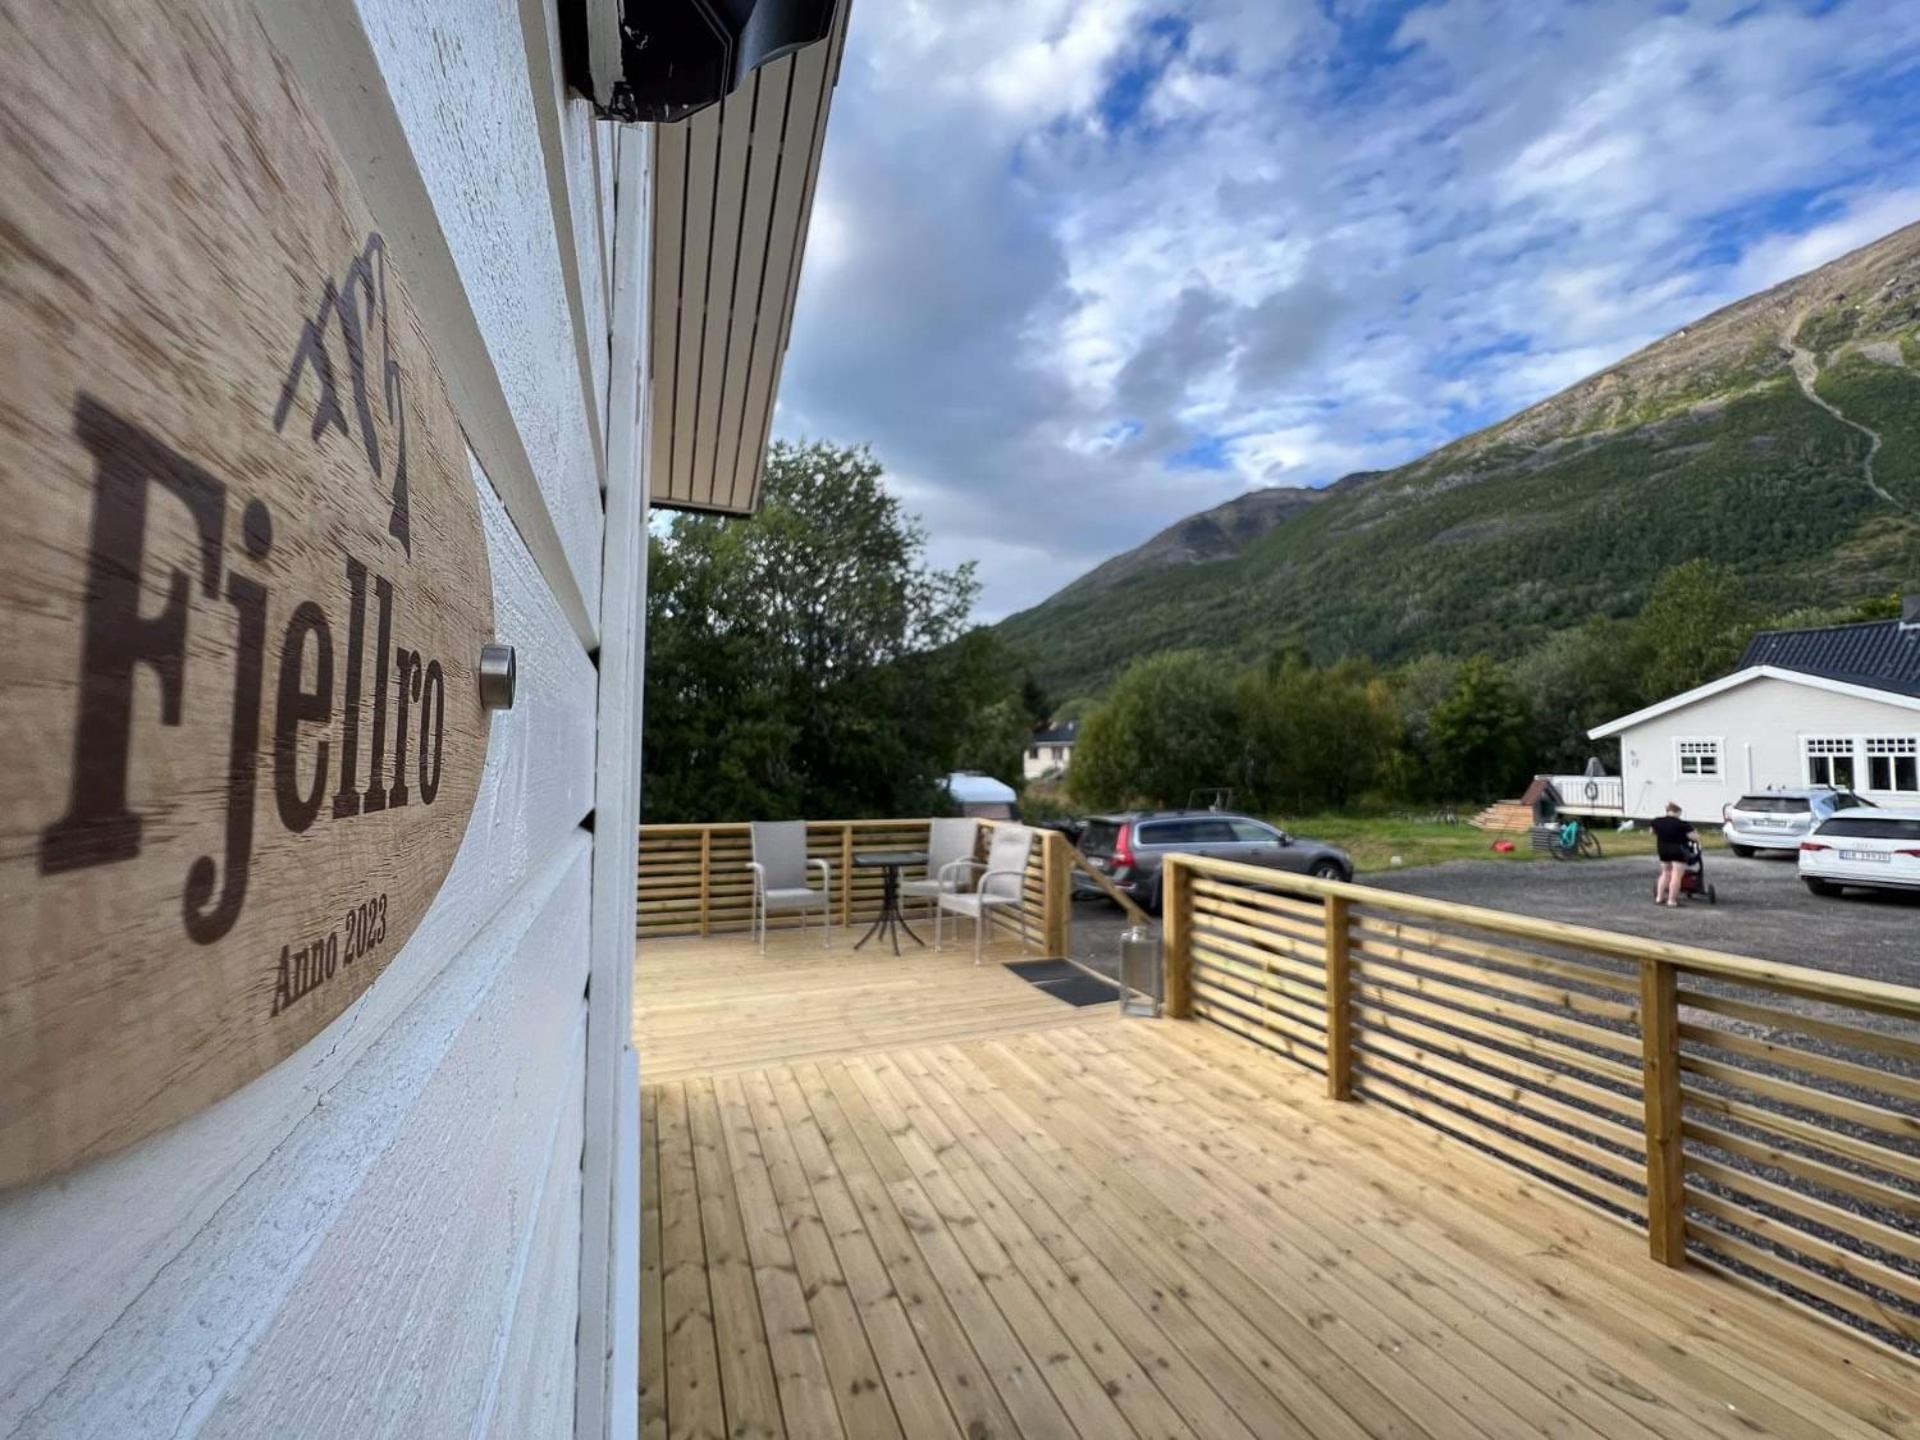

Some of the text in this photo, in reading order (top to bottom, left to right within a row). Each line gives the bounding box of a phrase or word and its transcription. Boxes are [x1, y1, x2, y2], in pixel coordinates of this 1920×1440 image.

[38, 388, 445, 946] Fjellro
[270, 893, 388, 1018] Anno 2023
